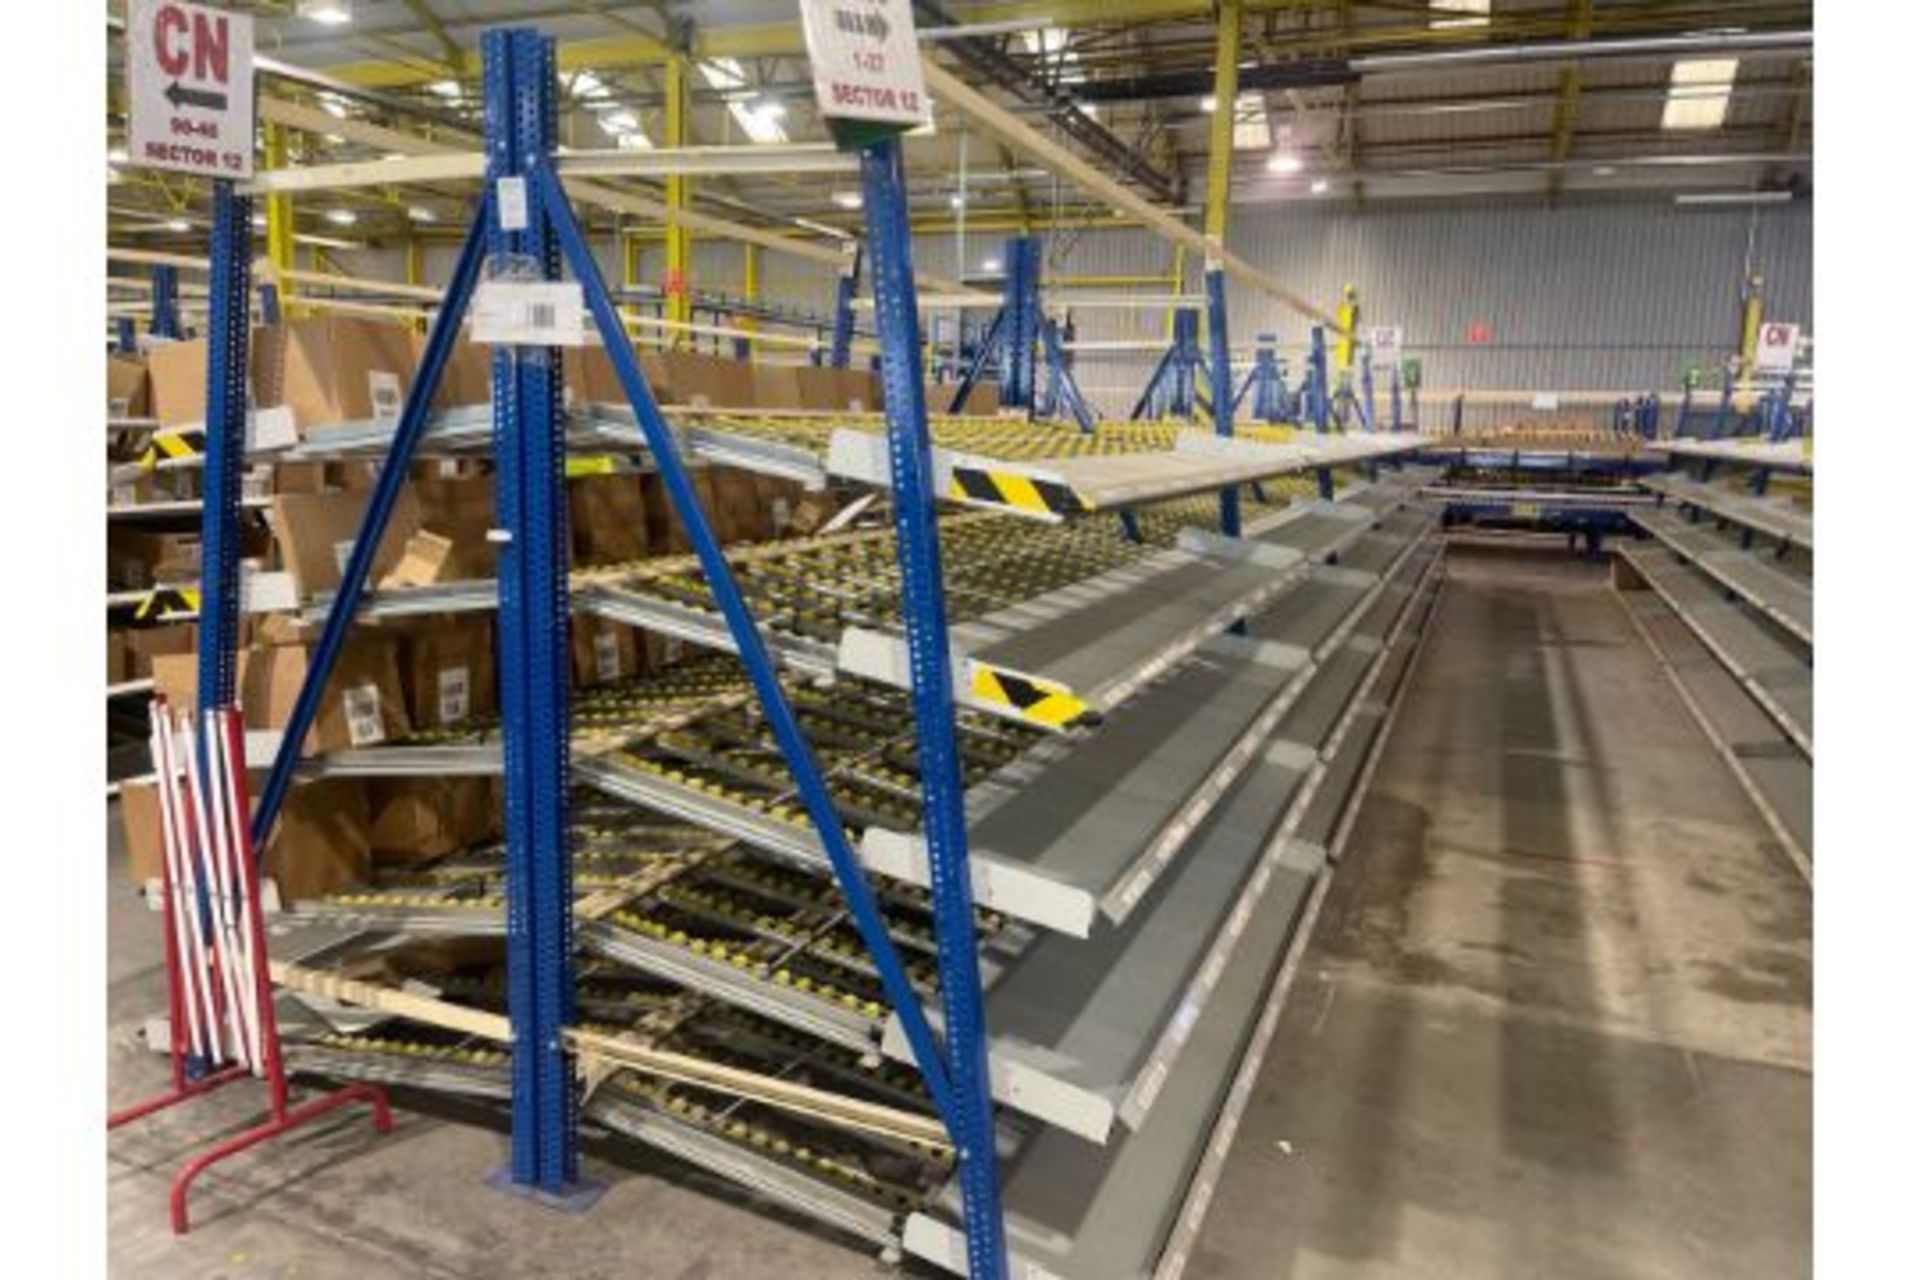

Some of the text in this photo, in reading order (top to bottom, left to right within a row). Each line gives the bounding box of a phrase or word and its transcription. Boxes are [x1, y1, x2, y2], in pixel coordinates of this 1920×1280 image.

[154, 5, 229, 85] CN
[831, 83, 897, 110] SECTOR
[145, 142, 242, 169] SECTOR 12
